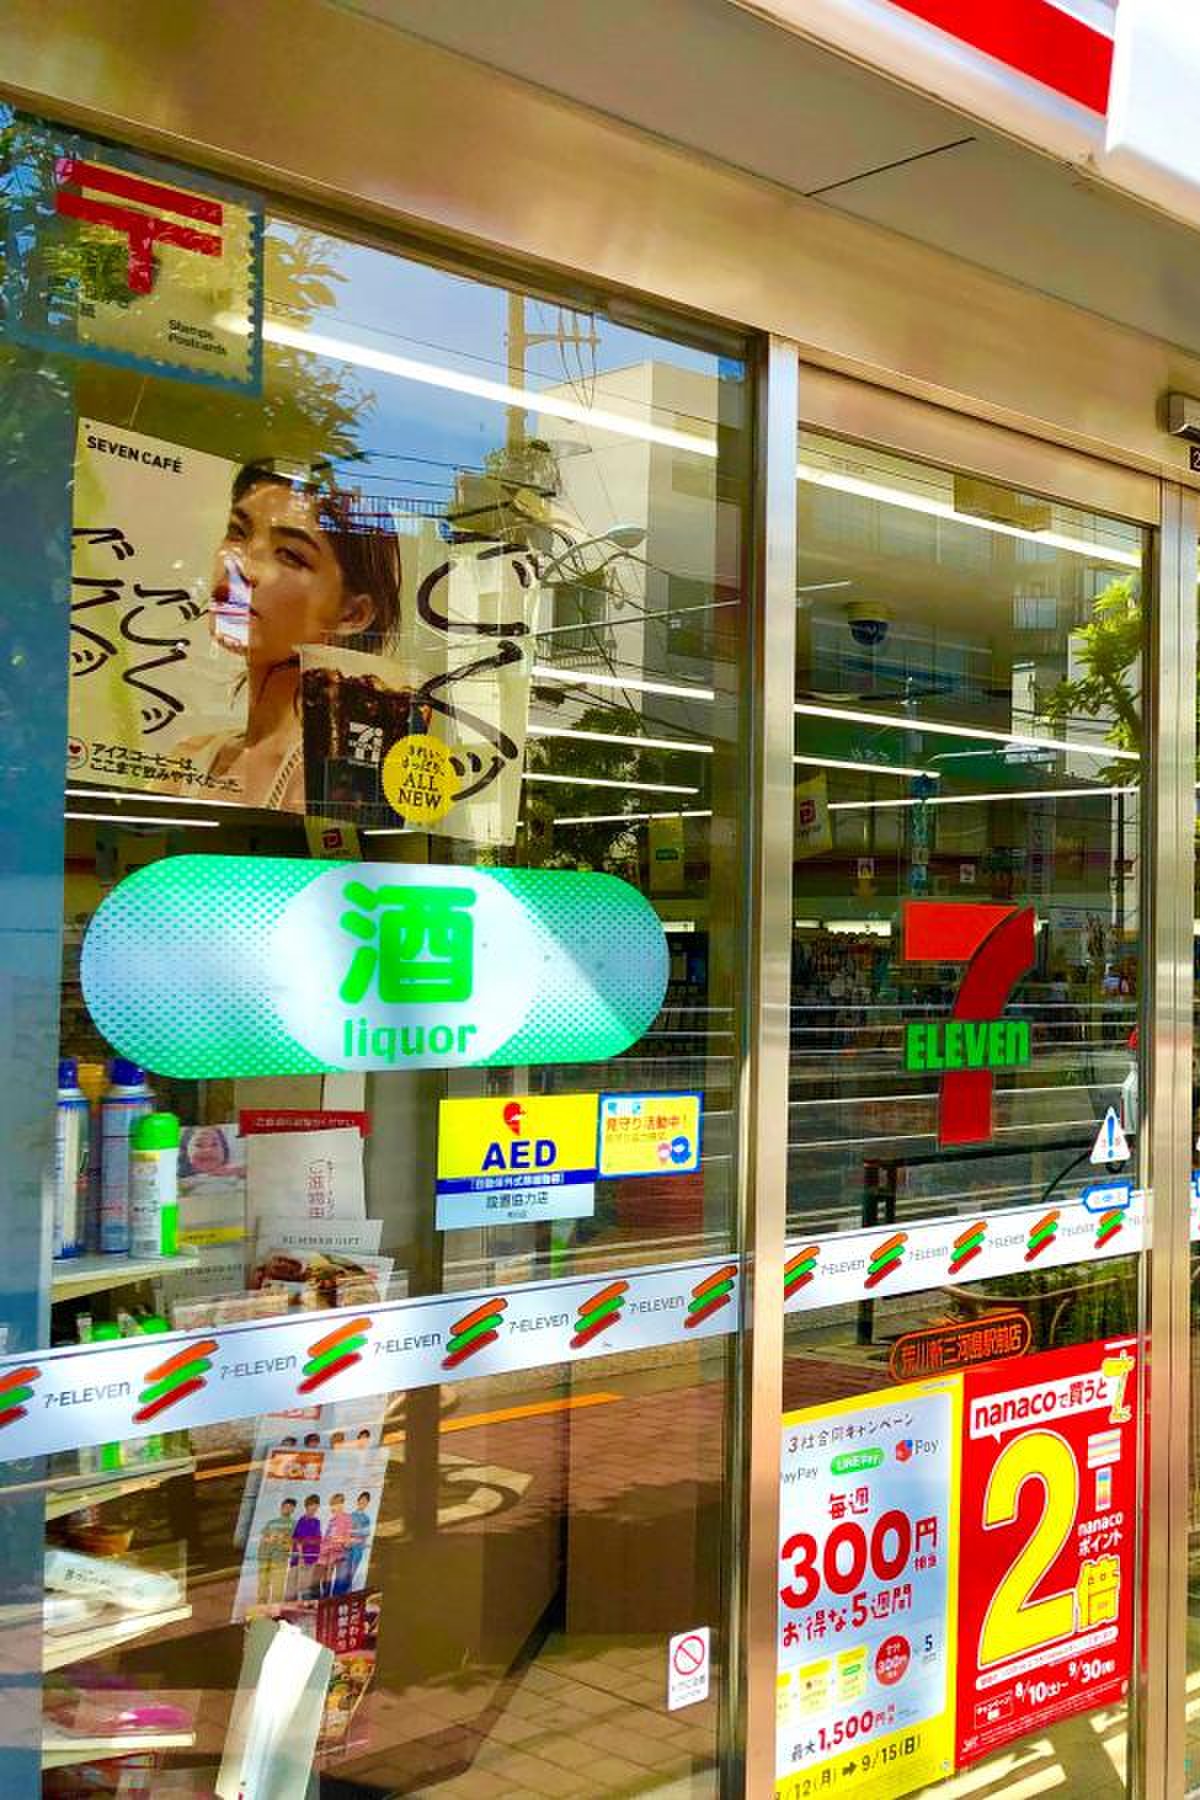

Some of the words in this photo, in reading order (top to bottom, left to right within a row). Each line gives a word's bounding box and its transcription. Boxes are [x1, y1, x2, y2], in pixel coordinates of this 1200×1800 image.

[168, 319, 214, 340] Stamps
[168, 333, 228, 355] Postcards
[87, 435, 139, 461] SEVEN
[142, 451, 183, 473] CAFÉ
[403, 773, 438, 792] ALL
[399, 789, 441, 810] NEW
[338, 880, 478, 1005] 酒
[342, 1017, 478, 1065] liquor
[481, 1139, 557, 1171] AED
[788, 1413, 913, 1453] 3社合同キャンペーン
[915, 1440, 939, 1455] Pay
[829, 1486, 869, 1520] 毎週
[1077, 1512, 1124, 1537] nanaco
[1078, 1530, 1123, 1556] ポイント
[783, 1583, 912, 1648] お得な5週間
